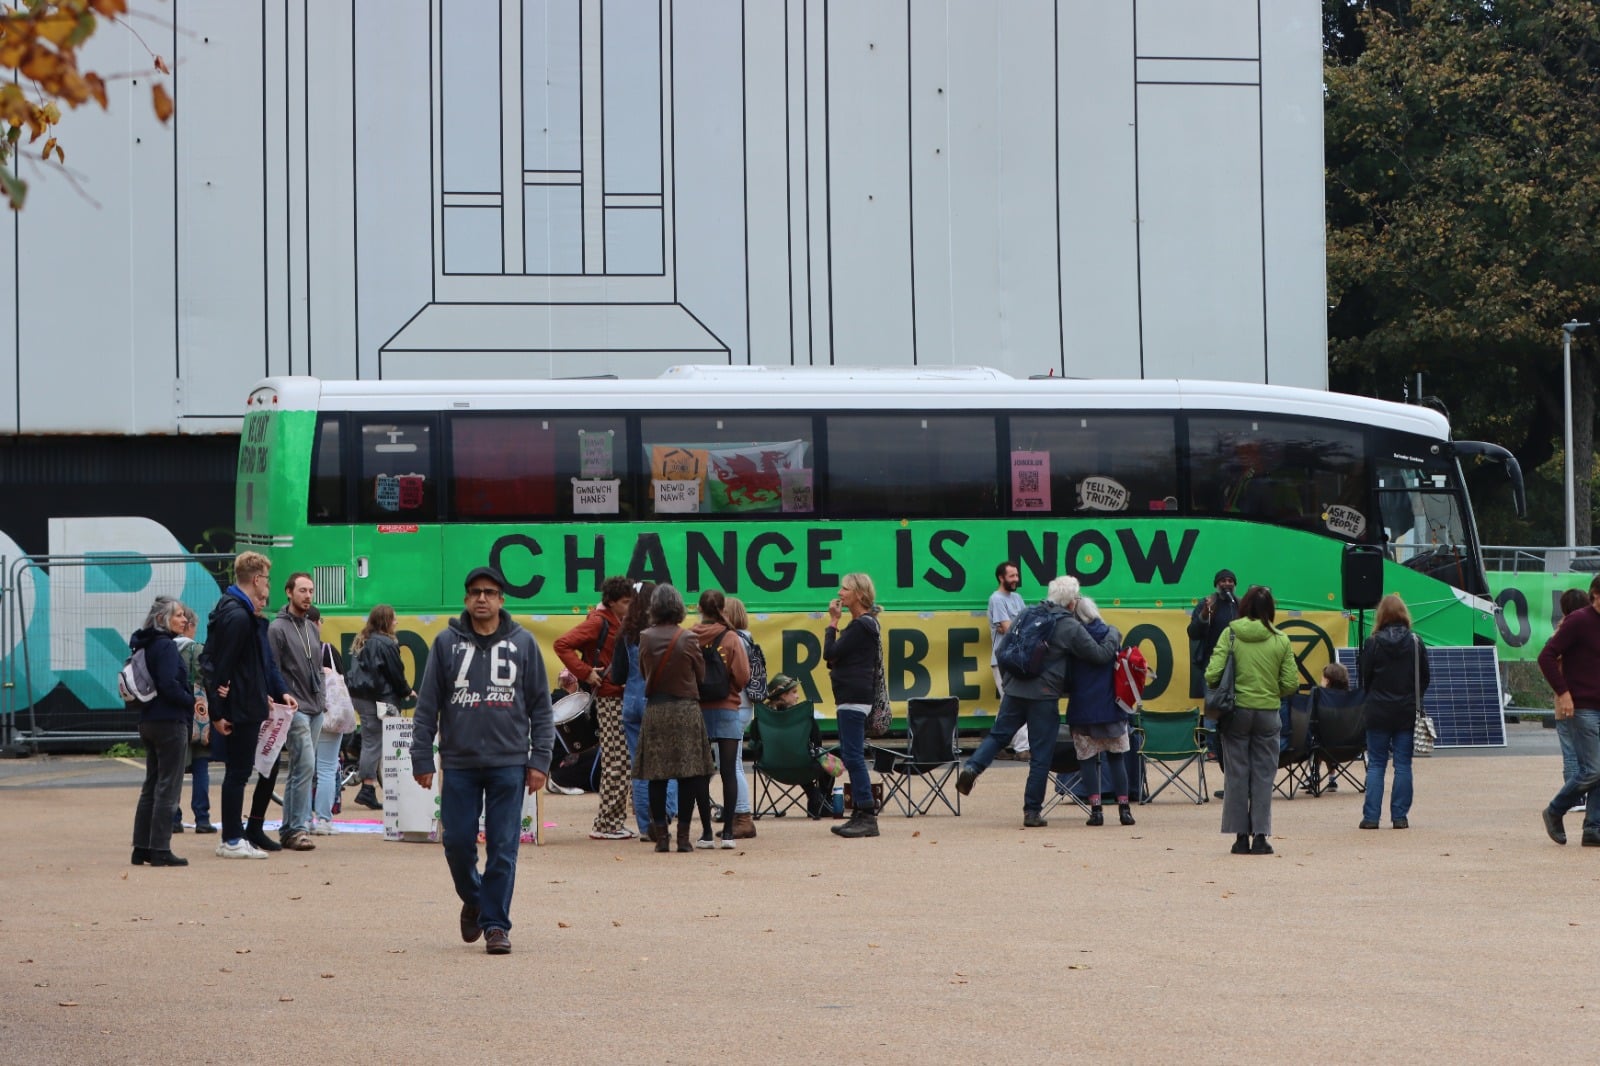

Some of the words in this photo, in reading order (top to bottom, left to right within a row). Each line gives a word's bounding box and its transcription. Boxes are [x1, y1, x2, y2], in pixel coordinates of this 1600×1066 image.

[576, 485, 613, 495] GWNEWCH
[660, 483, 685, 493] NEWID
[1086, 481, 1105, 494] TELL
[1107, 485, 1125, 500] THE
[580, 495, 606, 504] HANES
[660, 493, 685, 502] NAWR
[1086, 491, 1120, 509] TRUTH!
[1328, 507, 1345, 518] ASK
[1346, 510, 1362, 525] THE
[1329, 517, 1359, 534] PEOPLE
[489, 528, 842, 599] CHANGE
[896, 529, 970, 593] IS
[1007, 529, 1200, 588] NOW
[261, 718, 284, 756] EXTINCTION
